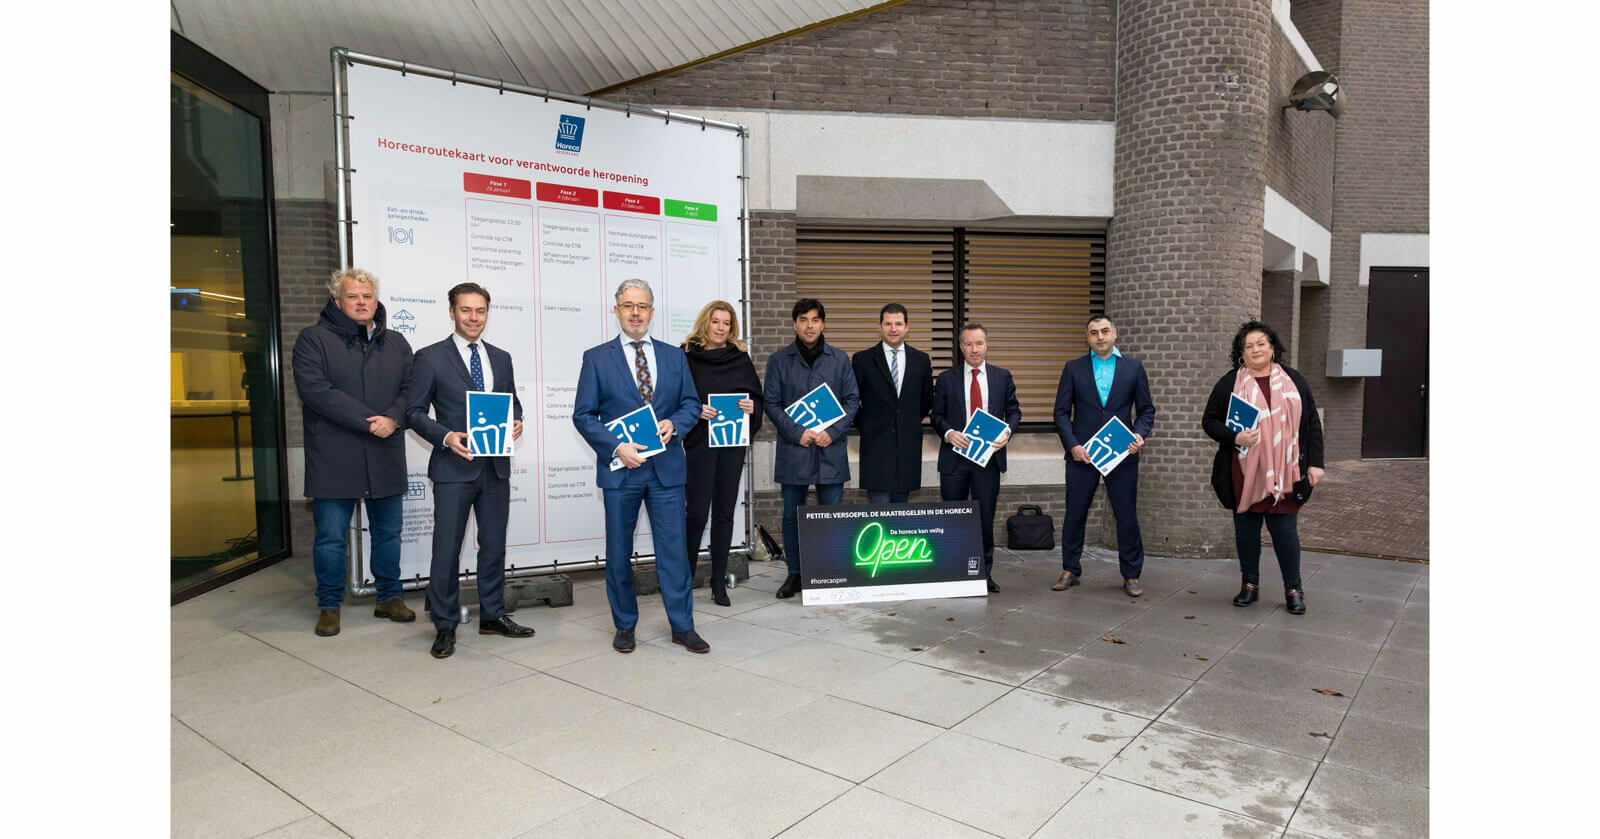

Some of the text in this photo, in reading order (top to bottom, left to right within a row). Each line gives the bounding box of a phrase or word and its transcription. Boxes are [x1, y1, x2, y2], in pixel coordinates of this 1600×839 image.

[556, 141, 580, 152] Horeca
[378, 138, 648, 186] Horecaroutekaart voor verantwoorde heropening
[498, 247, 521, 255] placering
[390, 296, 436, 304] Buitenterrassen
[856, 522, 932, 578] Open
